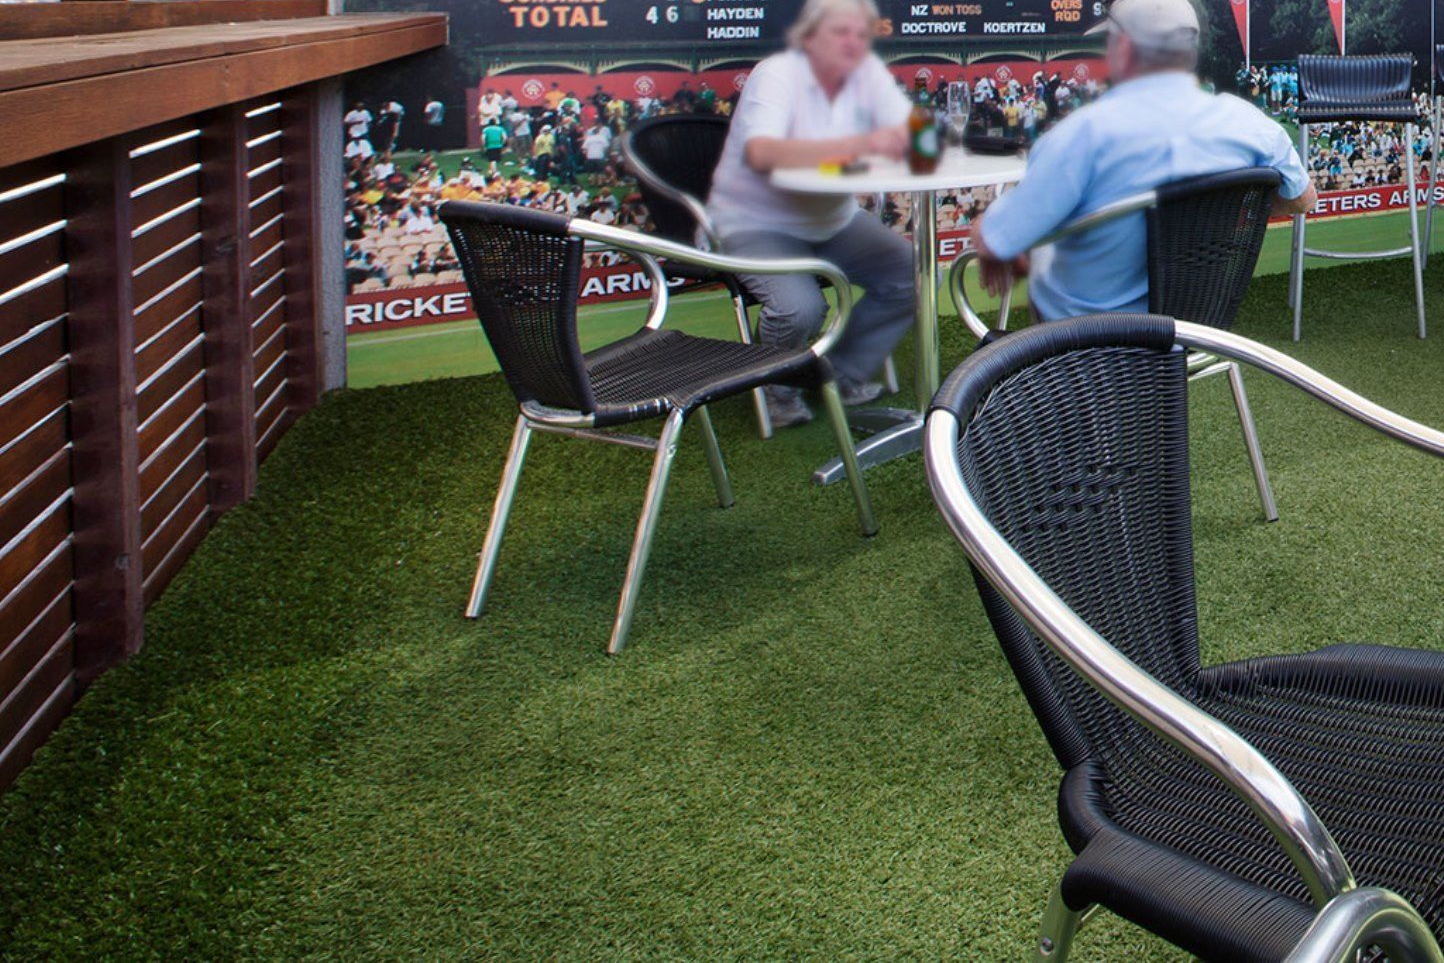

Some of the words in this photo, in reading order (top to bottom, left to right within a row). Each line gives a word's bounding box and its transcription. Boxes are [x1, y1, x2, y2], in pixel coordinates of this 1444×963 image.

[509, 6, 608, 27] TOTAL
[707, 8, 764, 20] HAYDEN
[911, 5, 928, 16] NZ
[932, 4, 954, 15] WON
[956, 4, 982, 15] TOSS
[707, 26, 760, 39] HADDIN
[901, 21, 966, 34] DOCTROVE
[983, 21, 1046, 33] KOERTZEN
[345, 292, 471, 326] RICKE
